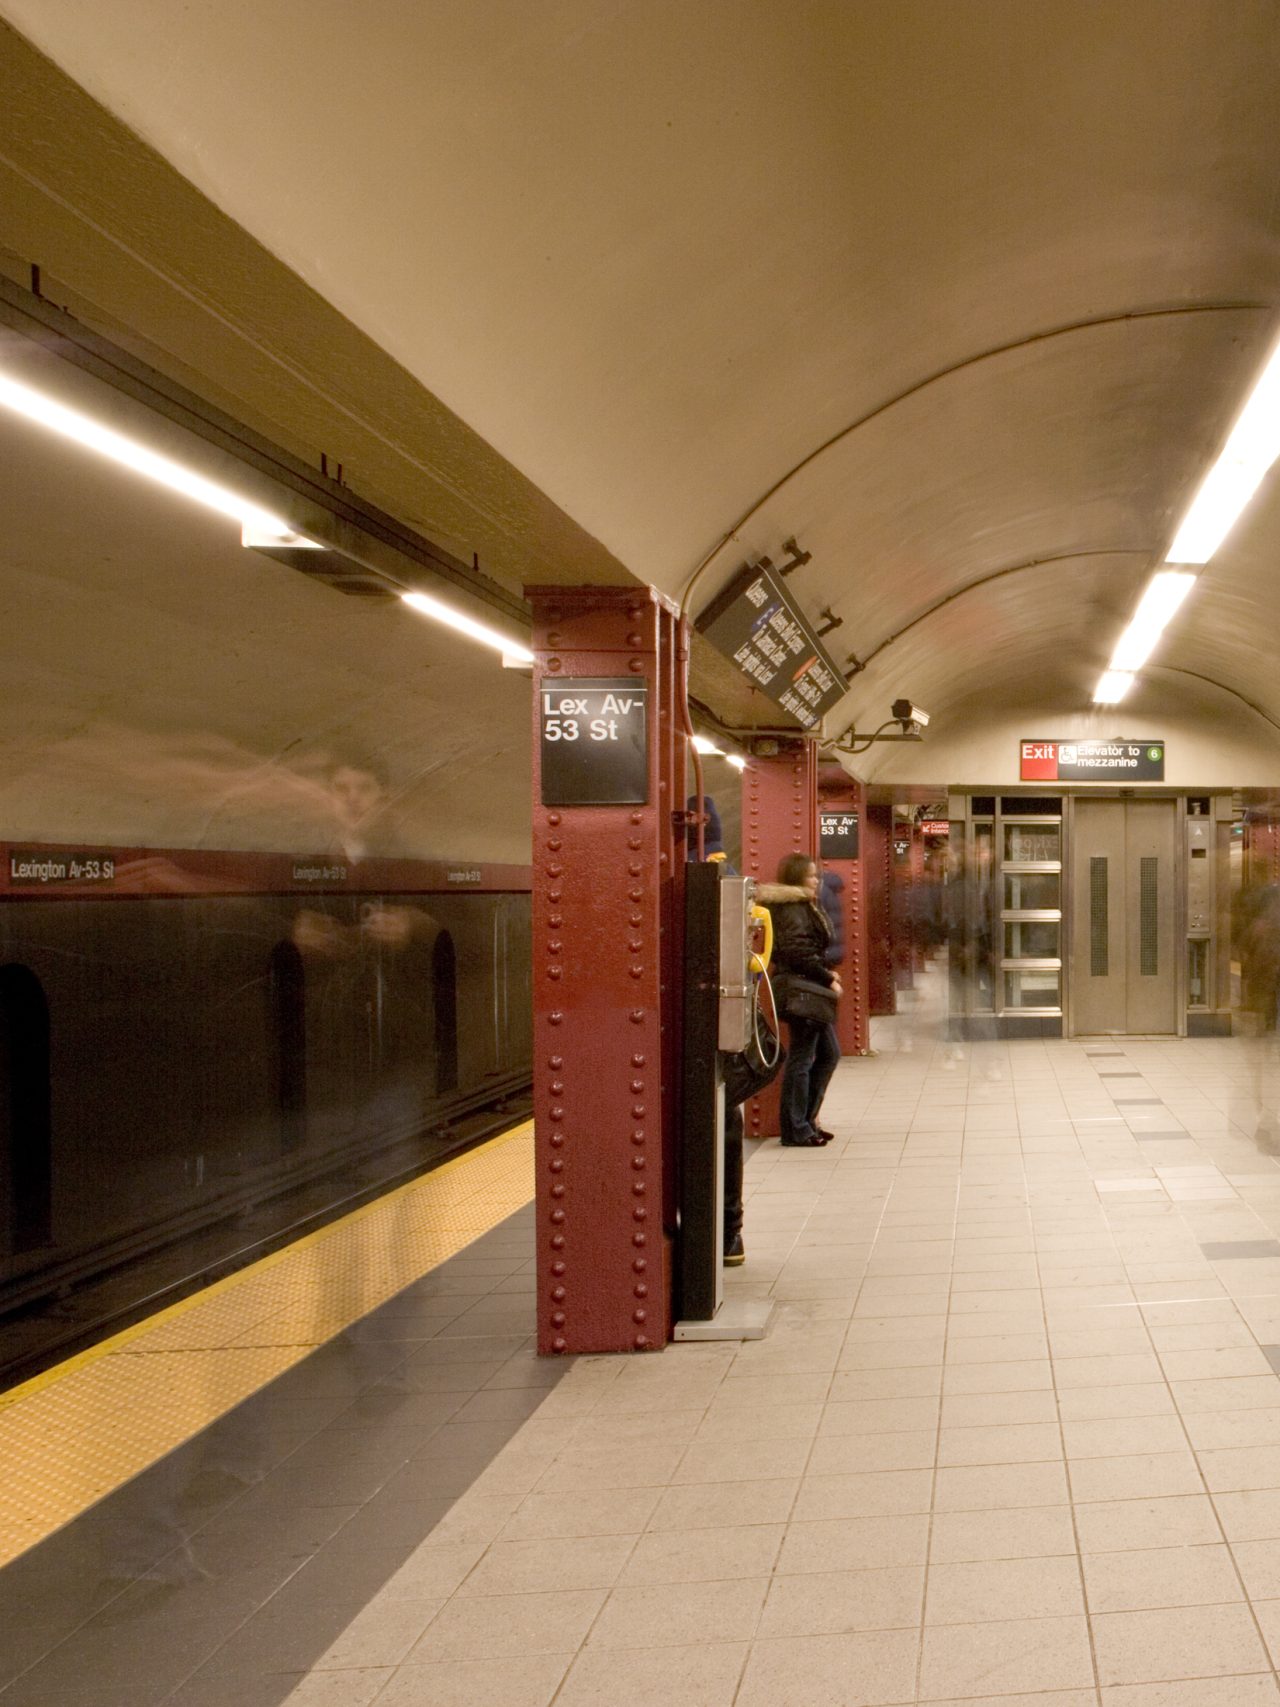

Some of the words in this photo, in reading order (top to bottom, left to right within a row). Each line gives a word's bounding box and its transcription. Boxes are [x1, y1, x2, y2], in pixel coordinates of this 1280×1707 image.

[544, 694, 589, 715] Lex
[601, 694, 644, 715] Av-
[544, 719, 579, 741] 53
[590, 719, 618, 740] St
[1022, 745, 1055, 759] Exit
[1077, 745, 1123, 756] Elevator
[1128, 745, 1140, 756] to
[1150, 749, 1158, 758] 6
[1077, 757, 1138, 767] mezzanine
[821, 816, 837, 825] Lex
[841, 816, 858, 825] Av-
[821, 826, 834, 835] 53
[838, 826, 849, 835] St
[11, 859, 65, 881] Lexington
[69, 861, 99, 878] Av-53
[103, 861, 114, 878] St
